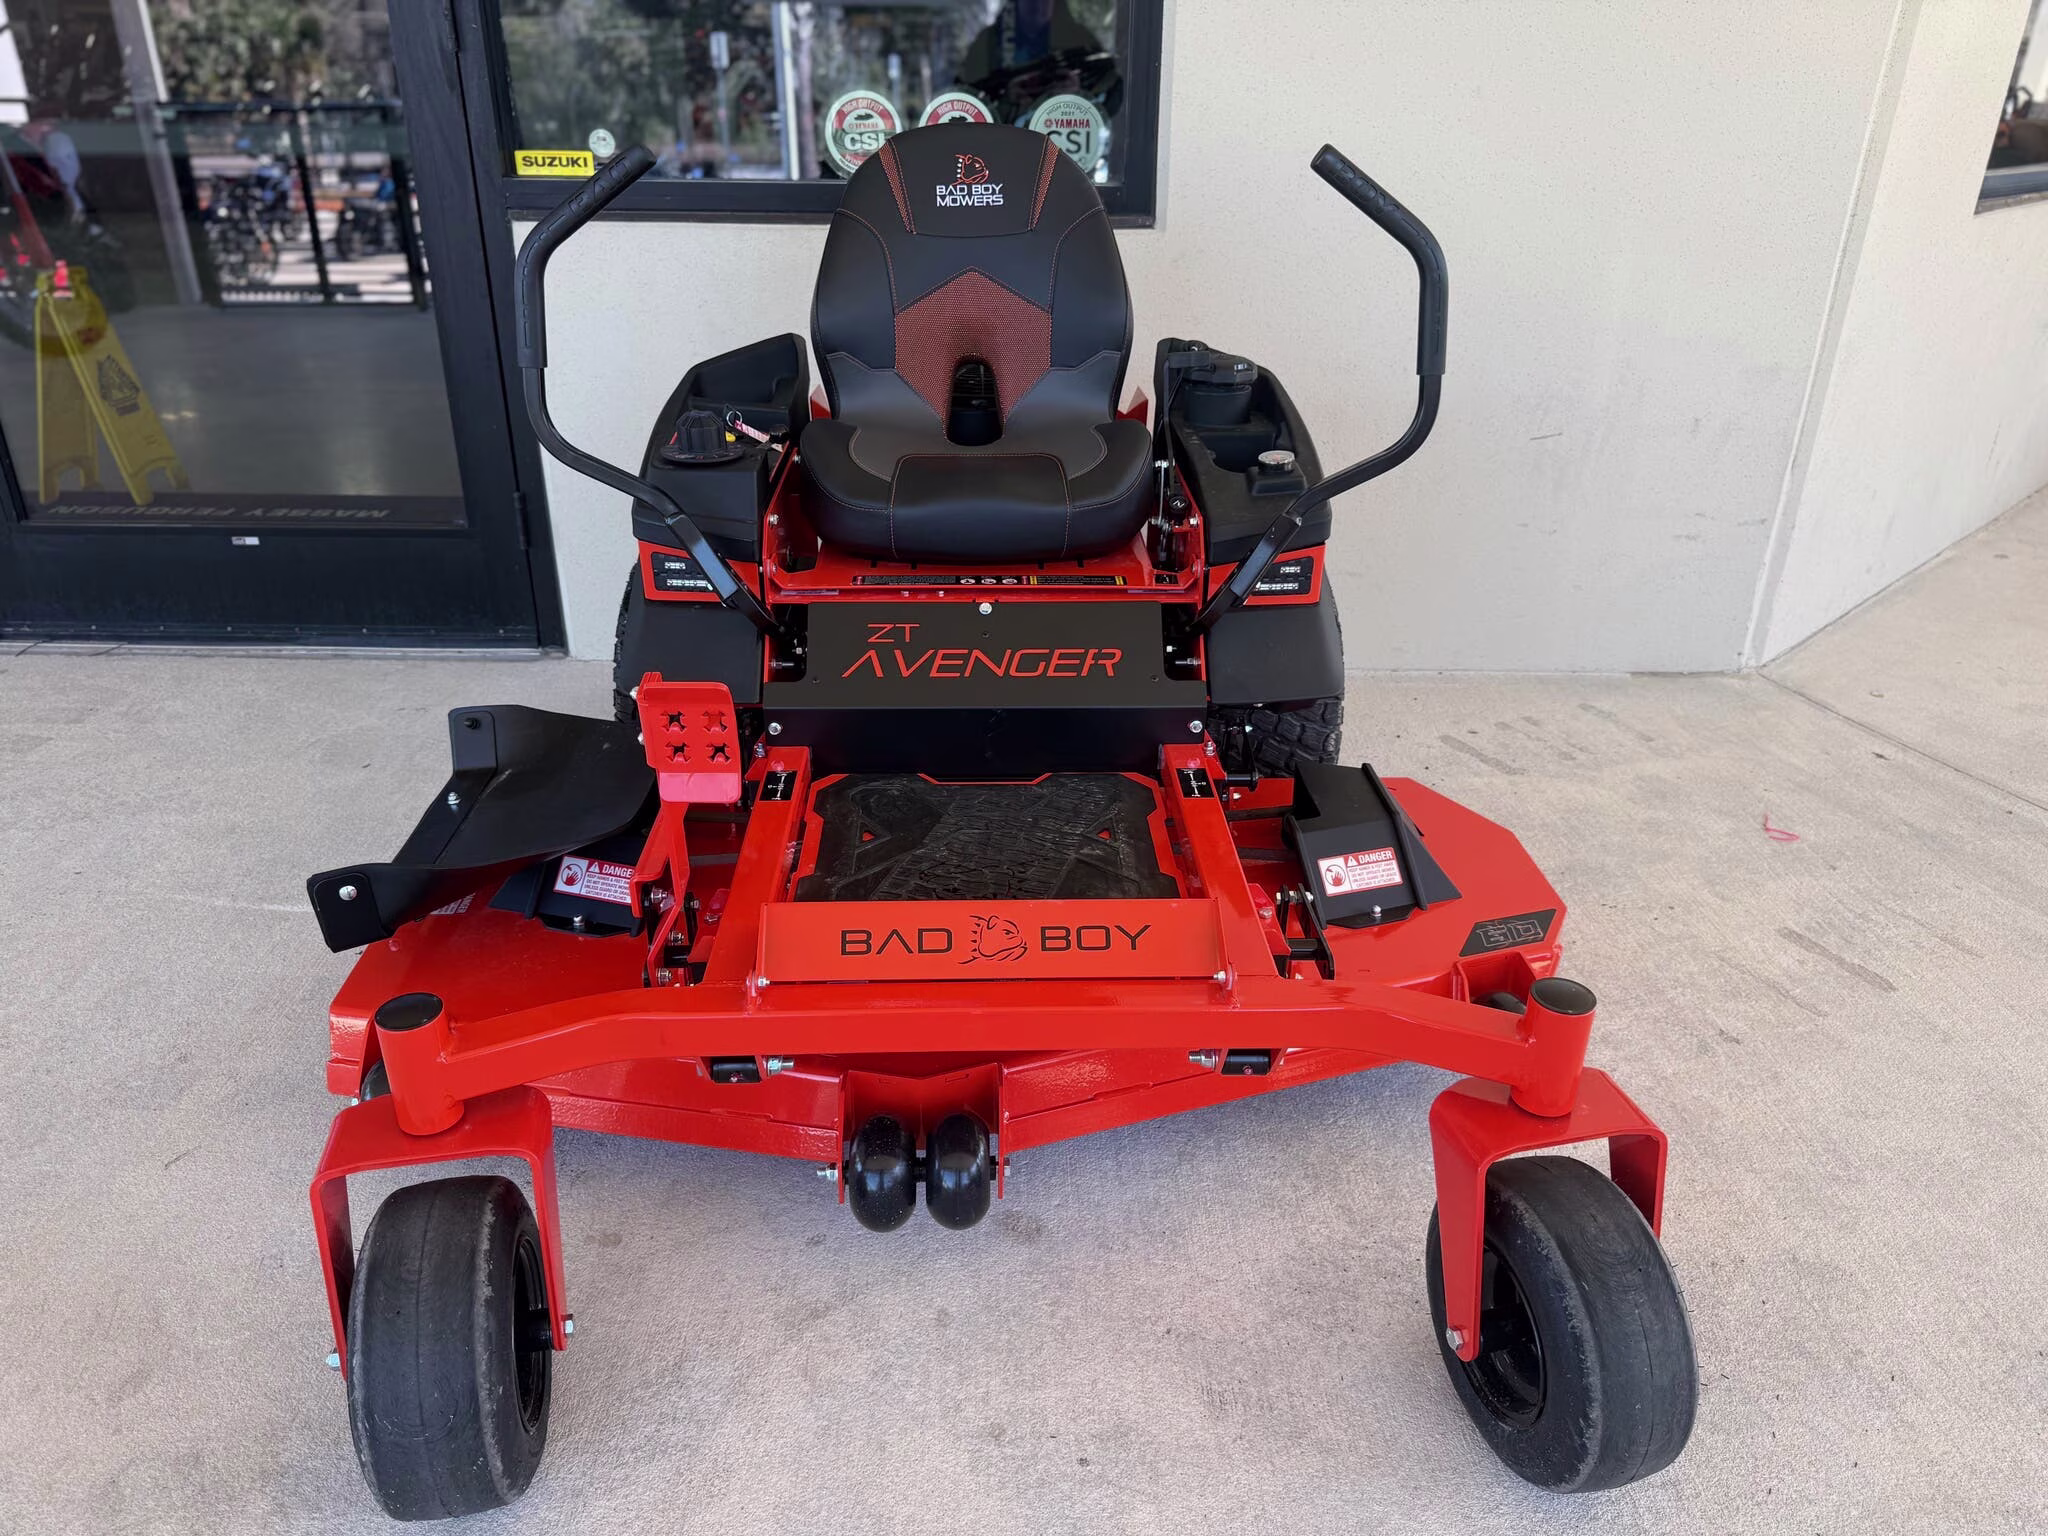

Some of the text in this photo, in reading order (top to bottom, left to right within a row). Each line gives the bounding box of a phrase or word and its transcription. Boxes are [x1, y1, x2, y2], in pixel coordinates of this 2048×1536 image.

[1055, 118, 1091, 129] YAMAHA
[522, 155, 588, 168] SUZUKI
[936, 183, 1003, 195] BAD BOY
[936, 195, 1004, 207] MOWERS
[47, 505, 391, 519] MASSEY FERGUSON
[867, 623, 921, 642] ZT
[841, 649, 1123, 677] AVENGER
[1358, 850, 1393, 864] DANGER
[602, 864, 636, 878] DANGE
[841, 924, 1152, 956] BAD BOY
